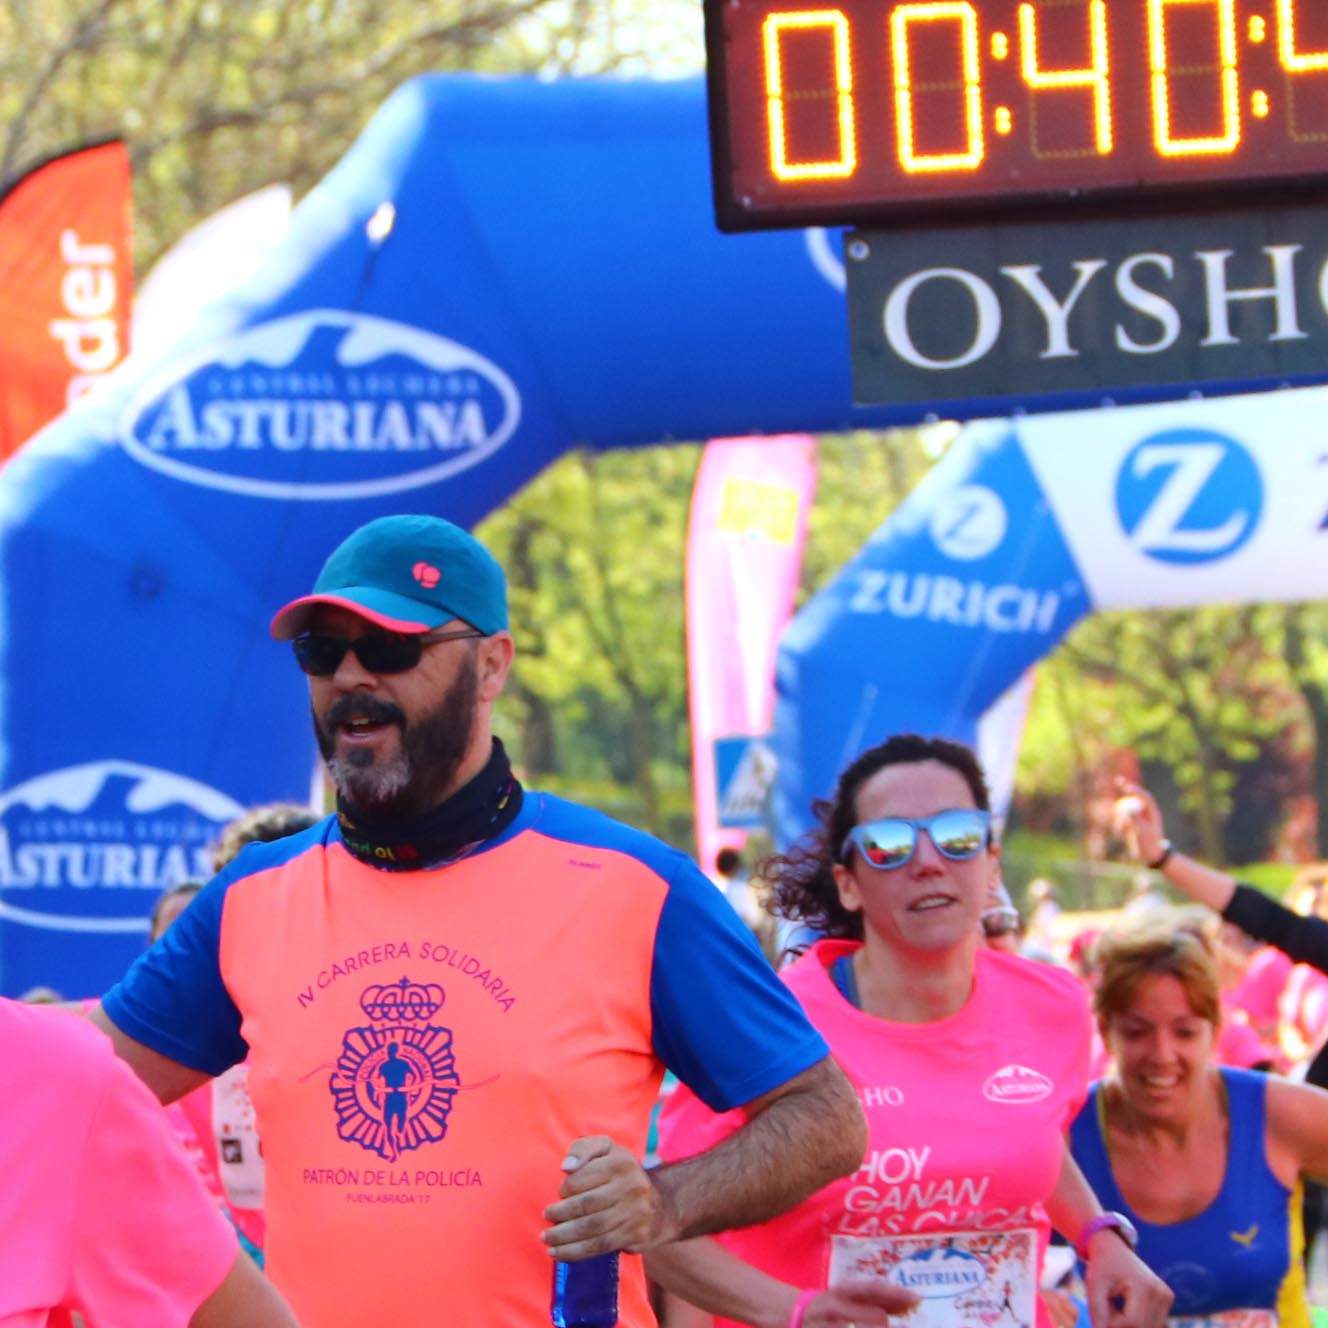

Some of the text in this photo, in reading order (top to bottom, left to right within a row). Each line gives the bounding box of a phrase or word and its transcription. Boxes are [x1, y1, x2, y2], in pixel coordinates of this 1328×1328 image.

[147, 379, 490, 452] ASTURIANA
[296, 941, 516, 1014] IV CARRERA SOLIDARIA
[302, 1165, 483, 1187] PATRÓN DE LA POLICÍA
[852, 1146, 932, 1184] HOY
[843, 1175, 990, 1214] GANAN
[895, 1269, 980, 1289] ASTURIANA
